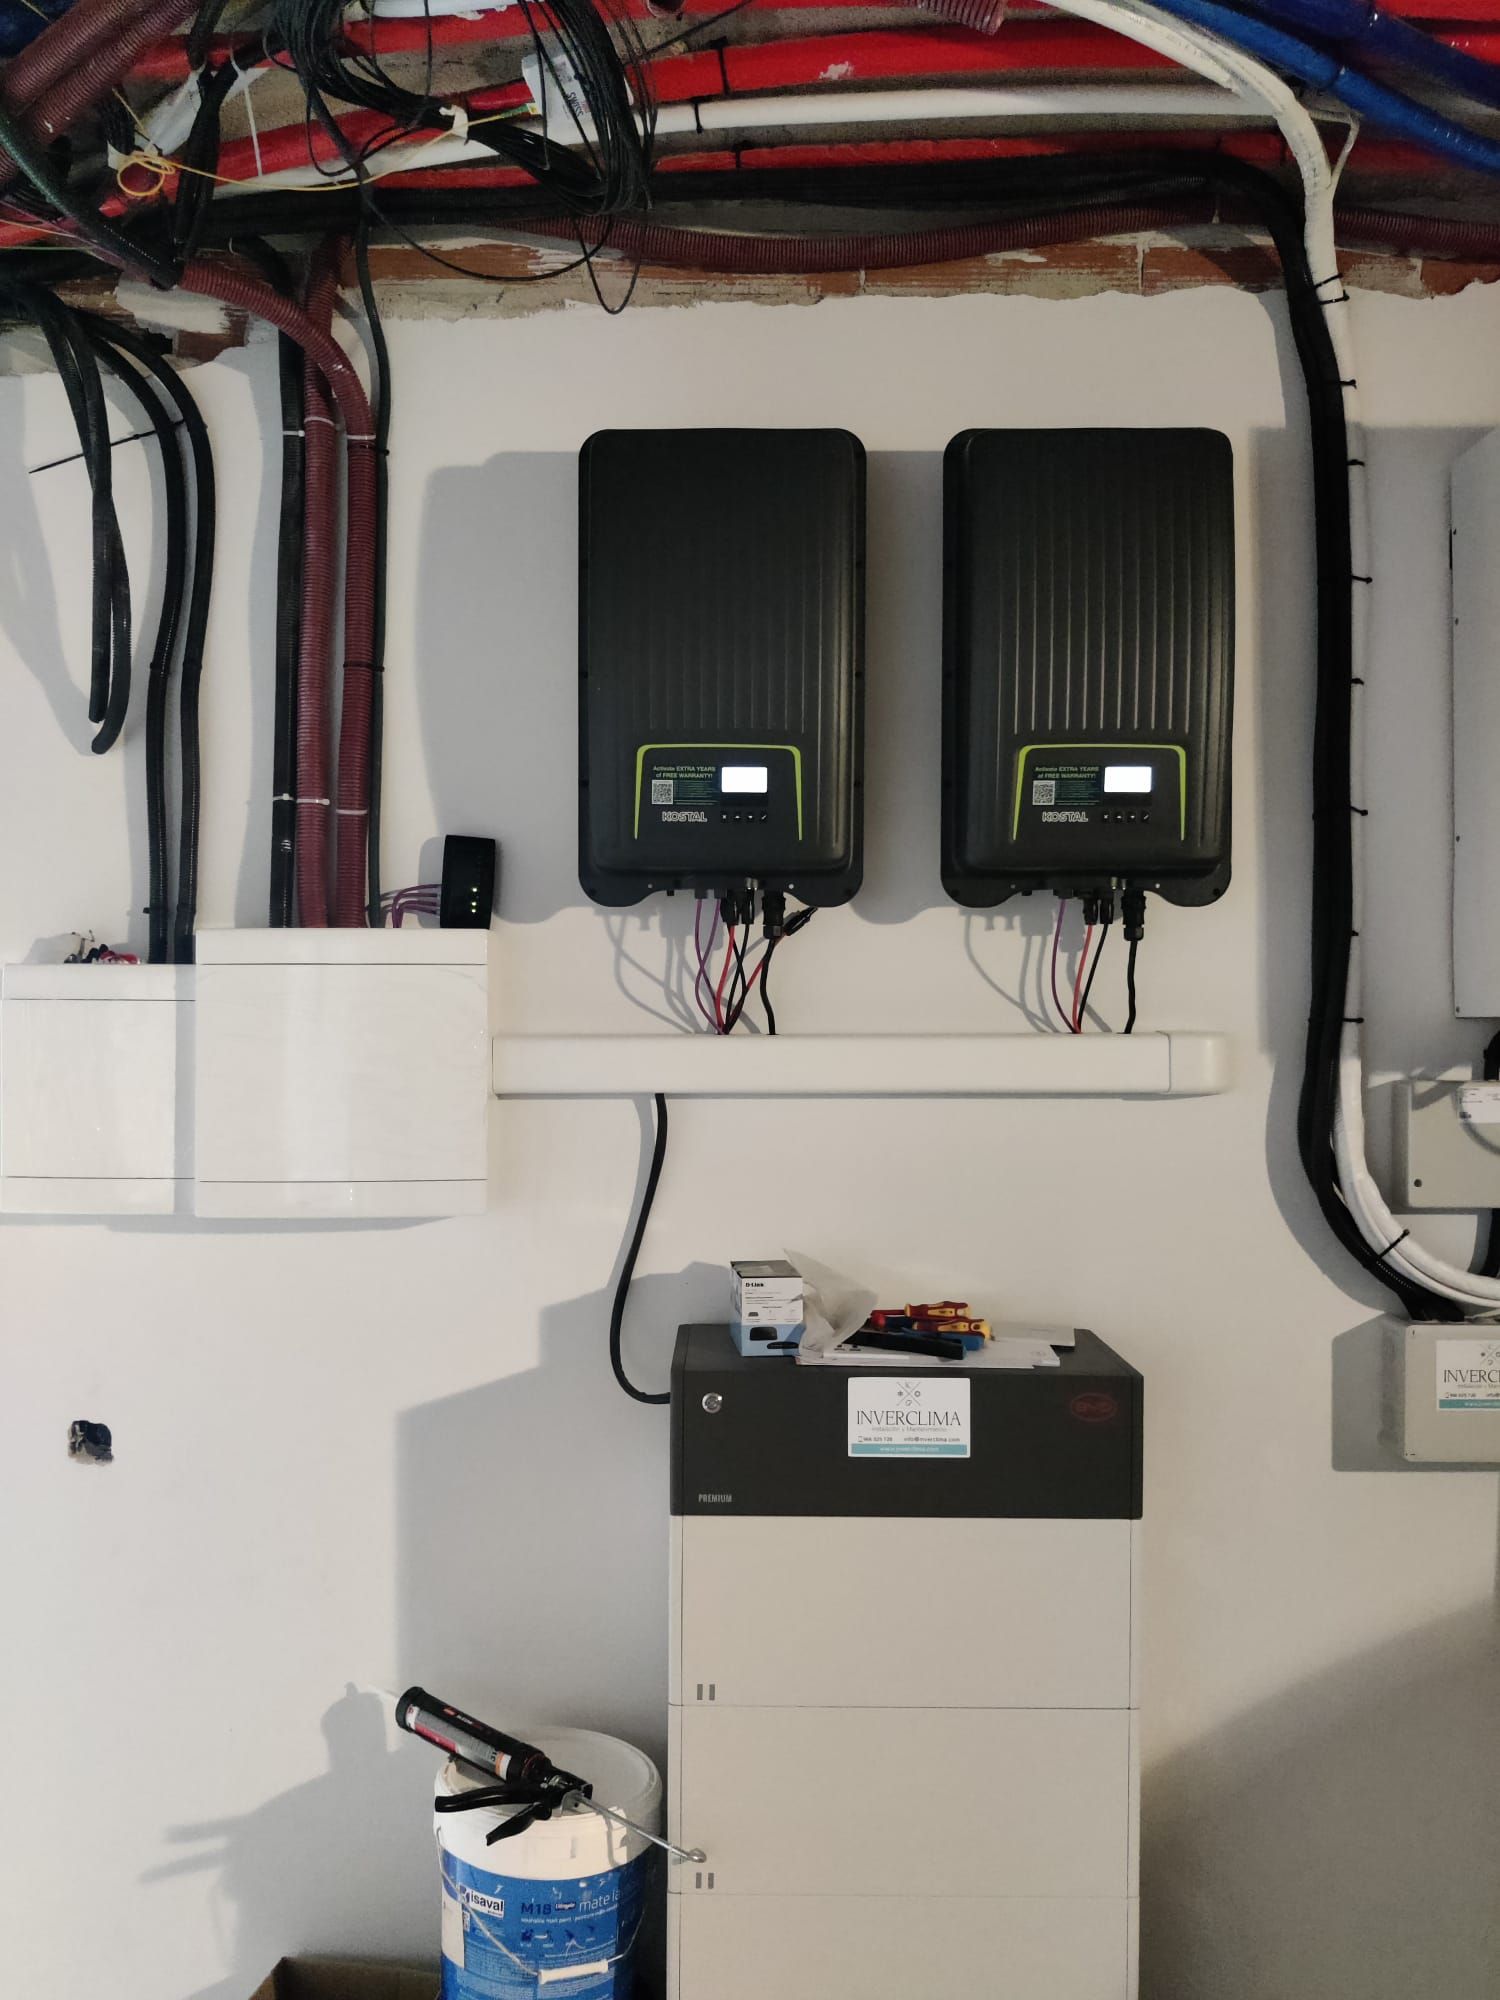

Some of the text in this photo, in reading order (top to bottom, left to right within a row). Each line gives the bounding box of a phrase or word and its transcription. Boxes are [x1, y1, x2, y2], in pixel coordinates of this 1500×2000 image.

[662, 811, 708, 822] KOSTAL
[1042, 811, 1088, 822] KOSTAL
[1444, 1369, 1500, 1383] INVERC
[857, 1410, 961, 1426] INVERCLIMA
[698, 1493, 732, 1503] PREMIUM
[471, 1891, 504, 1912] isaval
[521, 1902, 552, 1915] M18
[579, 1894, 610, 1912] mate
